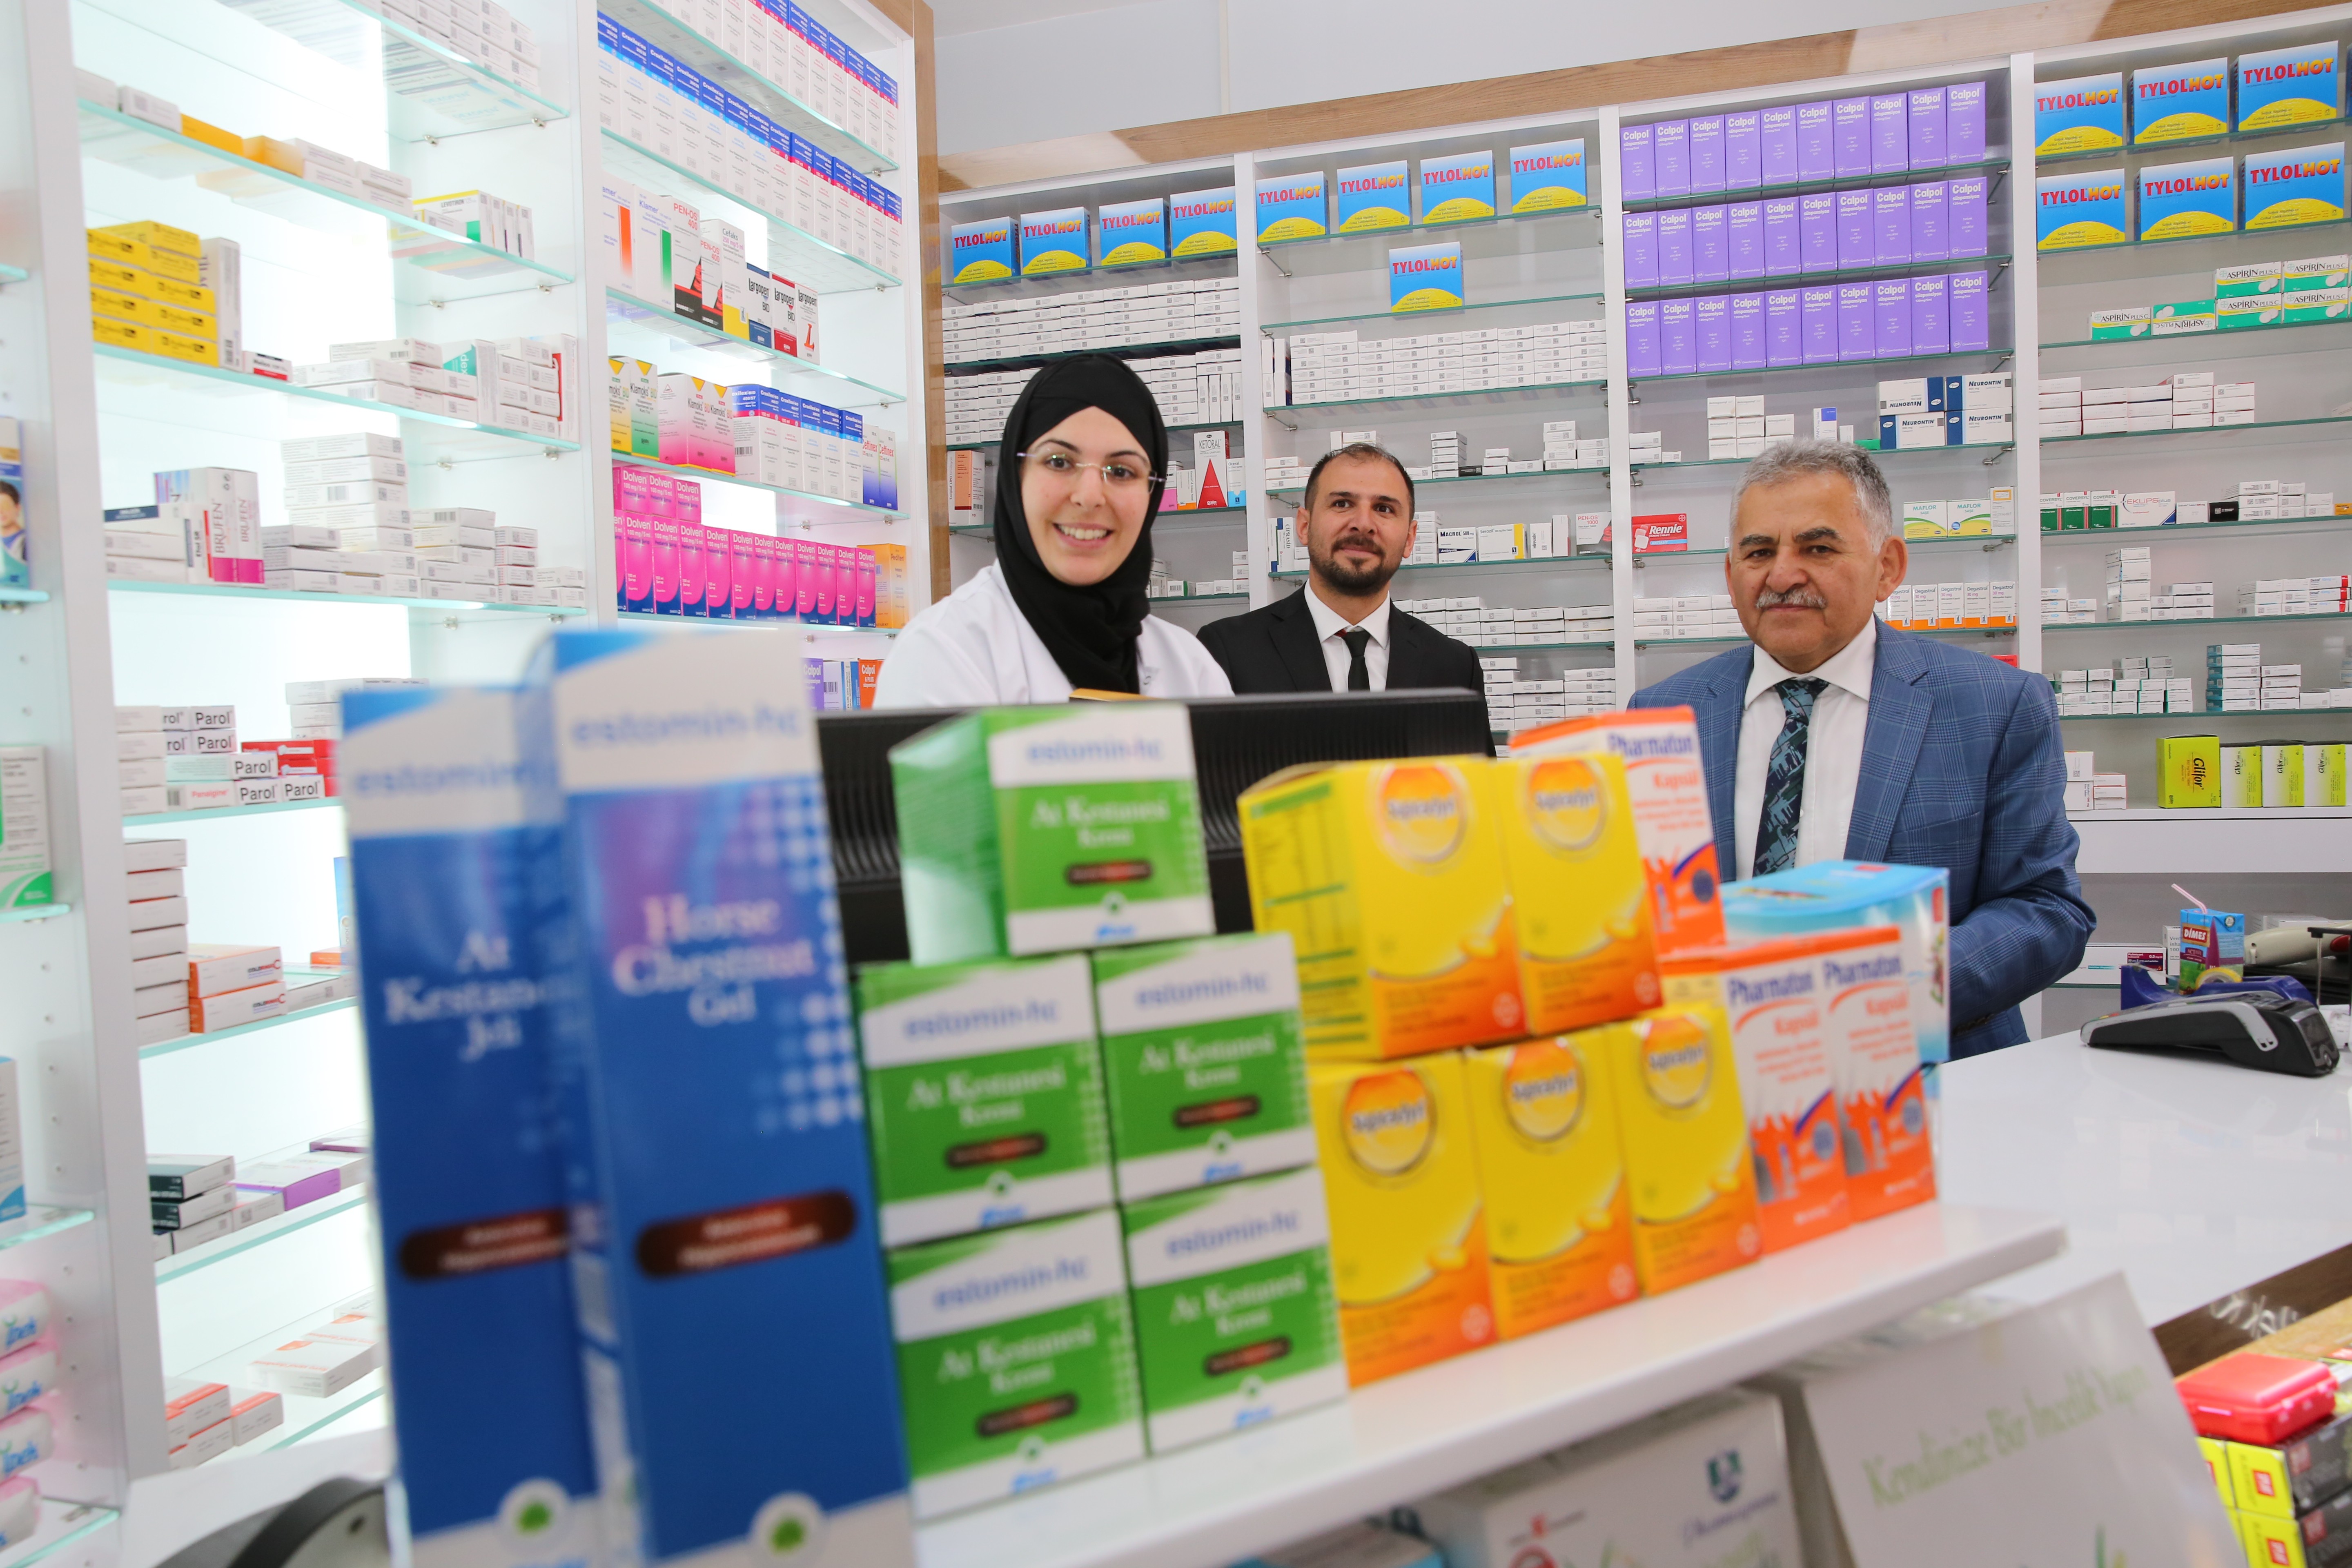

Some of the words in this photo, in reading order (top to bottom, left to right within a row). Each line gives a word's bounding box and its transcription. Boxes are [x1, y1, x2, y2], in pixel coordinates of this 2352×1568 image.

[1912, 93, 1940, 105] Calpol
[1951, 88, 1980, 100] Calpol
[1837, 102, 1864, 114] Calpol
[1874, 98, 1902, 110] Calpol
[1764, 111, 1791, 122] Calpol
[1800, 106, 1827, 118] Calpol
[1693, 120, 1719, 131] Calpol
[1728, 116, 1755, 127] Calpol
[1623, 129, 1649, 140] Calpol
[1657, 125, 1684, 136] Calpol
[1877, 191, 1904, 203] Calpol
[639, 199, 658, 214] Klamer
[674, 203, 698, 221] PEN-OS
[1731, 206, 1757, 218] Calpol
[688, 219, 698, 230] 400
[1626, 217, 1652, 228] Calpol
[722, 228, 738, 241] Cefaks
[700, 240, 719, 255] PEN-OS
[711, 254, 719, 263] 400
[2294, 263, 2326, 272] ASPİRİN
[2227, 269, 2258, 279] ASPİRİN
[748, 278, 769, 298] Largopen
[775, 287, 794, 306] Largopen
[798, 289, 817, 307] Largopen
[2294, 293, 2326, 303] ASPİRİN
[2228, 299, 2259, 309] ASPİRİN
[2101, 313, 2130, 322] ASPİRİN
[630, 383, 648, 396] Klamoks
[688, 398, 703, 411] Klamoks
[710, 404, 725, 417] Klamoks
[1199, 439, 1220, 449] KETORAL
[624, 470, 647, 485] Dolven
[650, 475, 672, 489] Dolven
[240, 499, 249, 542] BRUFEN
[627, 517, 650, 530] Dolven
[215, 502, 225, 554] BRUFEN
[681, 526, 703, 537] Dolven
[1649, 524, 1682, 535] Rennie
[707, 530, 728, 541] Dolven
[733, 533, 753, 544] Dolven
[859, 551, 874, 561] Dolven
[862, 664, 875, 676] Calpol
[196, 711, 230, 725] Parol
[198, 735, 232, 749] Parol
[1608, 733, 1694, 757] Pharmaton
[235, 760, 271, 774] Parol
[2192, 757, 2206, 788] Glifor
[192, 790, 227, 799] Panalgine
[241, 786, 275, 801] Parol
[285, 782, 318, 796] Parol
[644, 894, 781, 945] Horse
[2184, 928, 2206, 940] DİMES
[612, 940, 815, 997] Chestnut
[1823, 952, 1902, 991] Pharmaton
[1728, 969, 1814, 1008] Pharmaton
